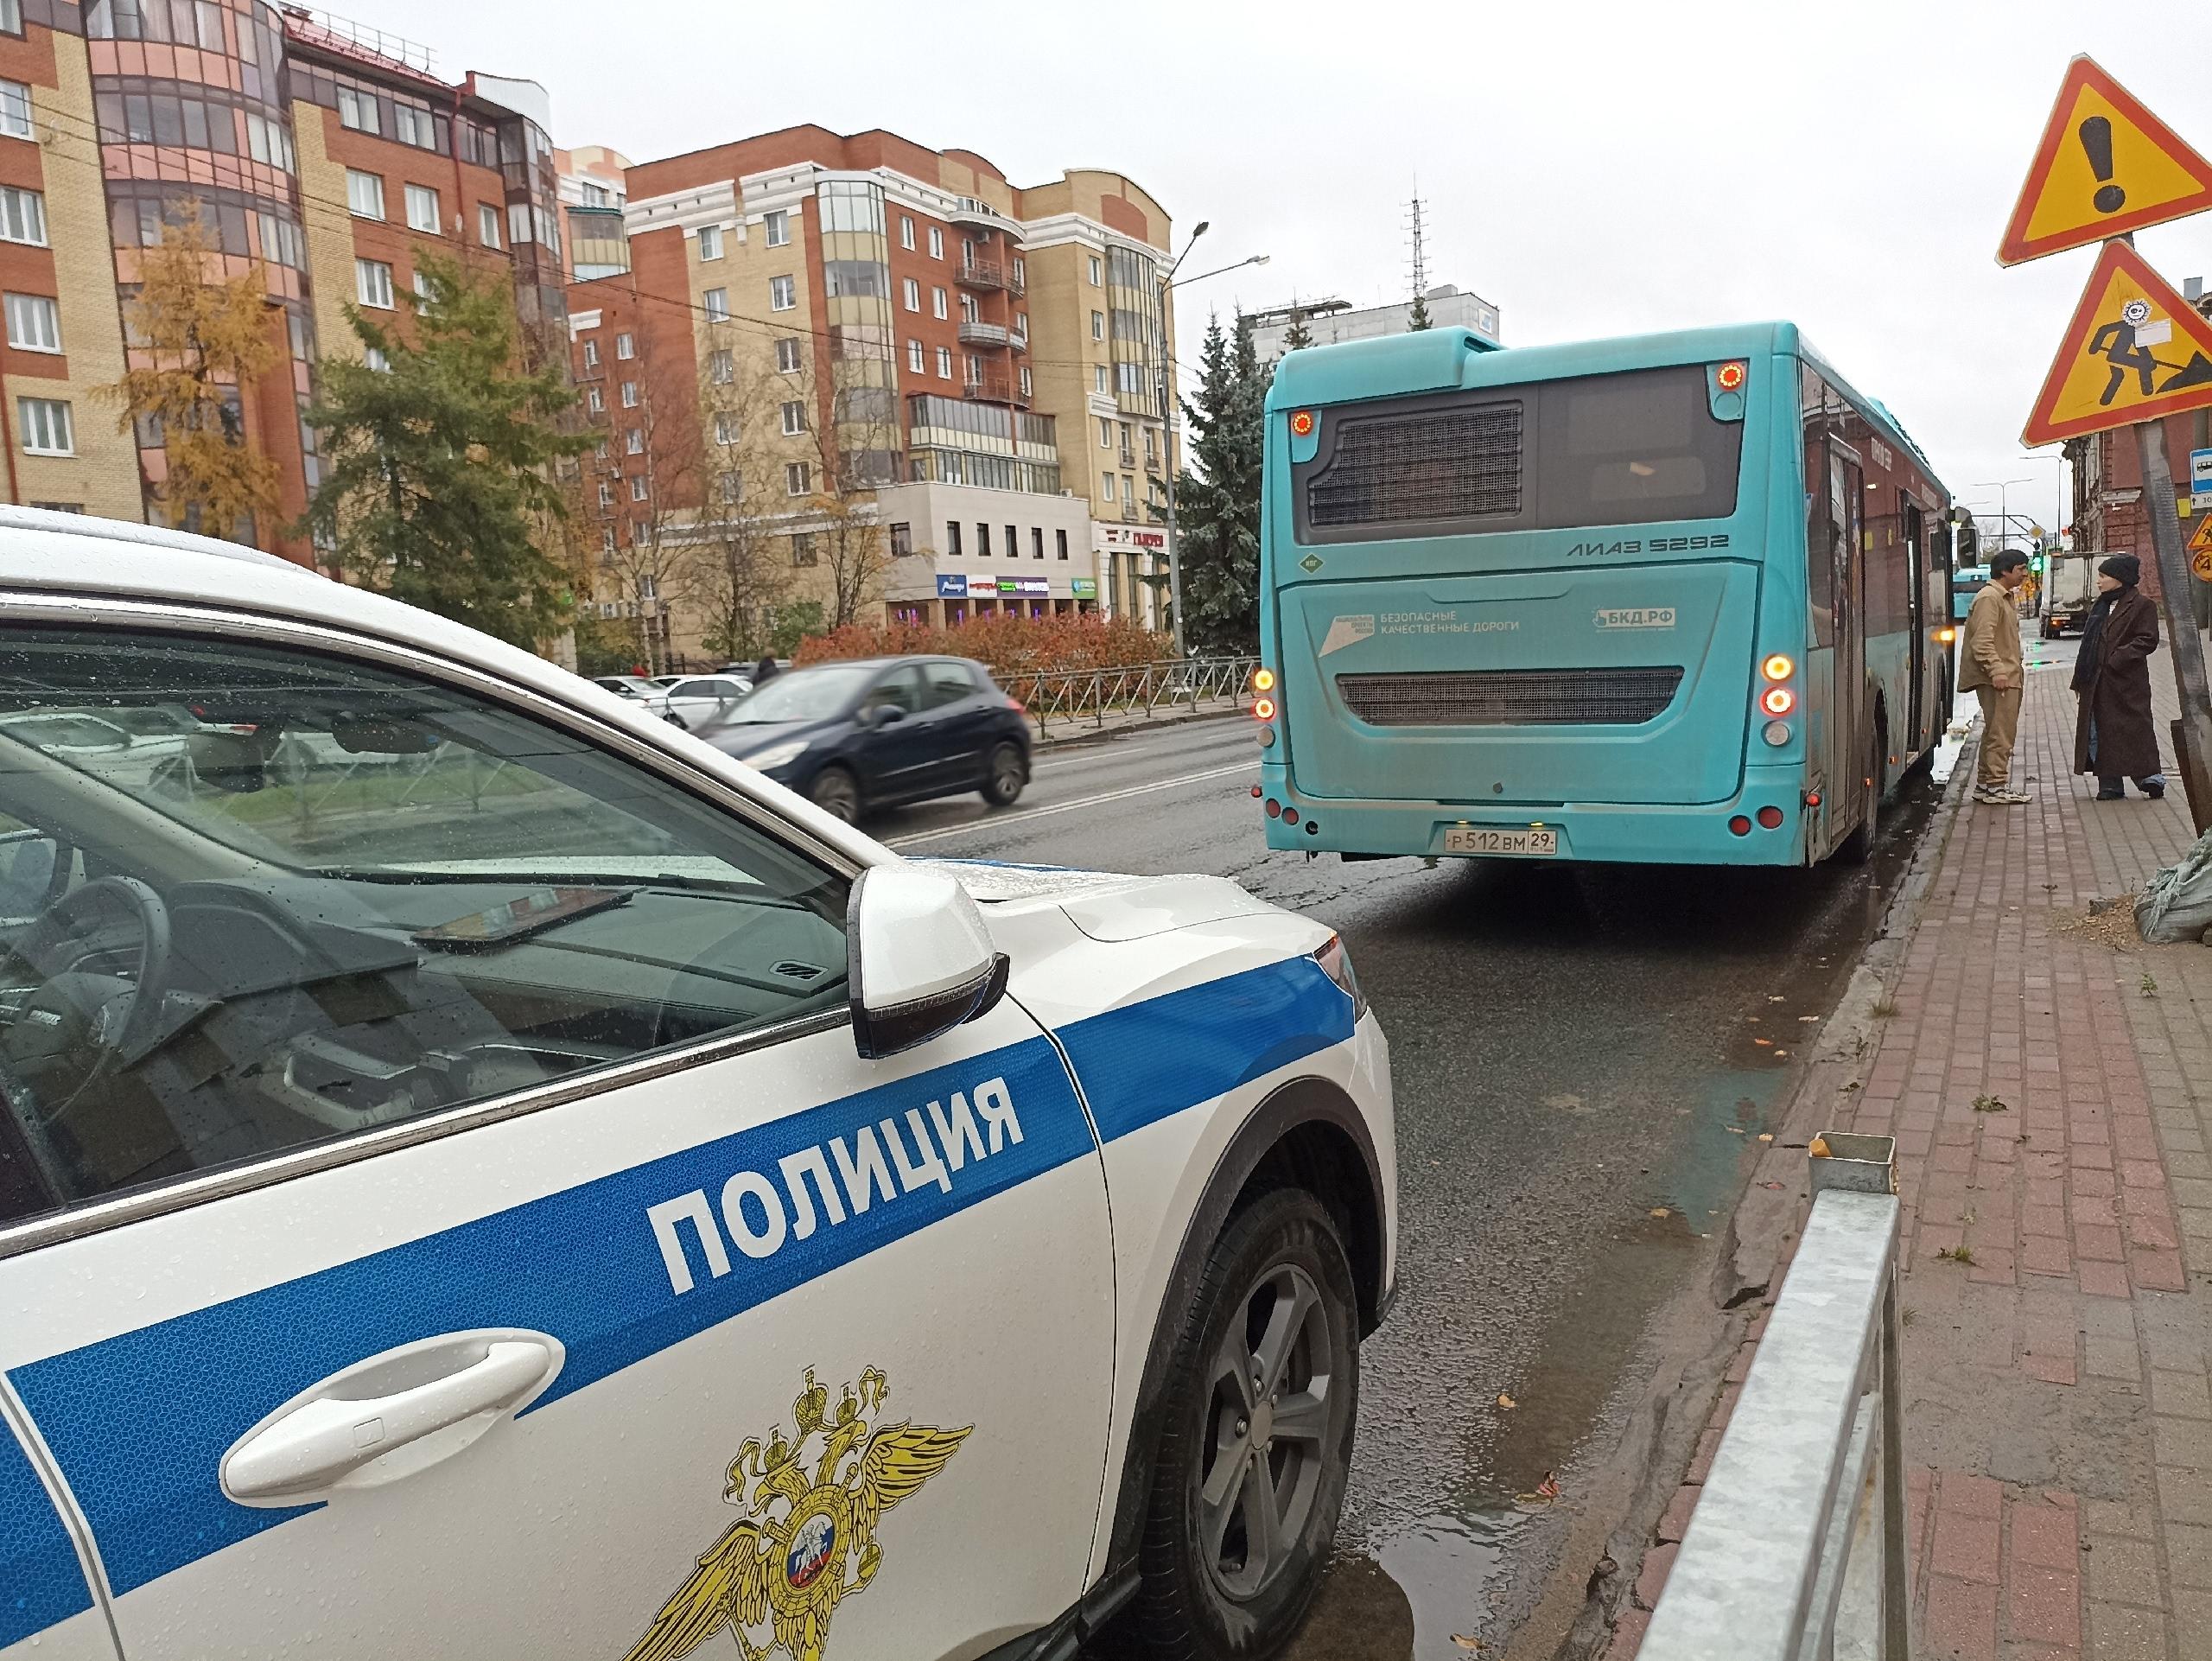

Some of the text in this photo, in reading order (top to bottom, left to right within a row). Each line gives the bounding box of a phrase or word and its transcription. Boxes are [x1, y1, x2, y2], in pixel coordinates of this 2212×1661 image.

[1567, 534, 1729, 557] ЛИАЗ 5292
[1381, 610, 1457, 623] БЕЗОПАСНЫЕ
[1608, 610, 1673, 625] БКД.РФ
[1381, 620, 1520, 634] КАЧЕСТВЕННЫЕ ДОРОГИ
[646, 1077, 1025, 1295] ПОЛИЦИЯ
